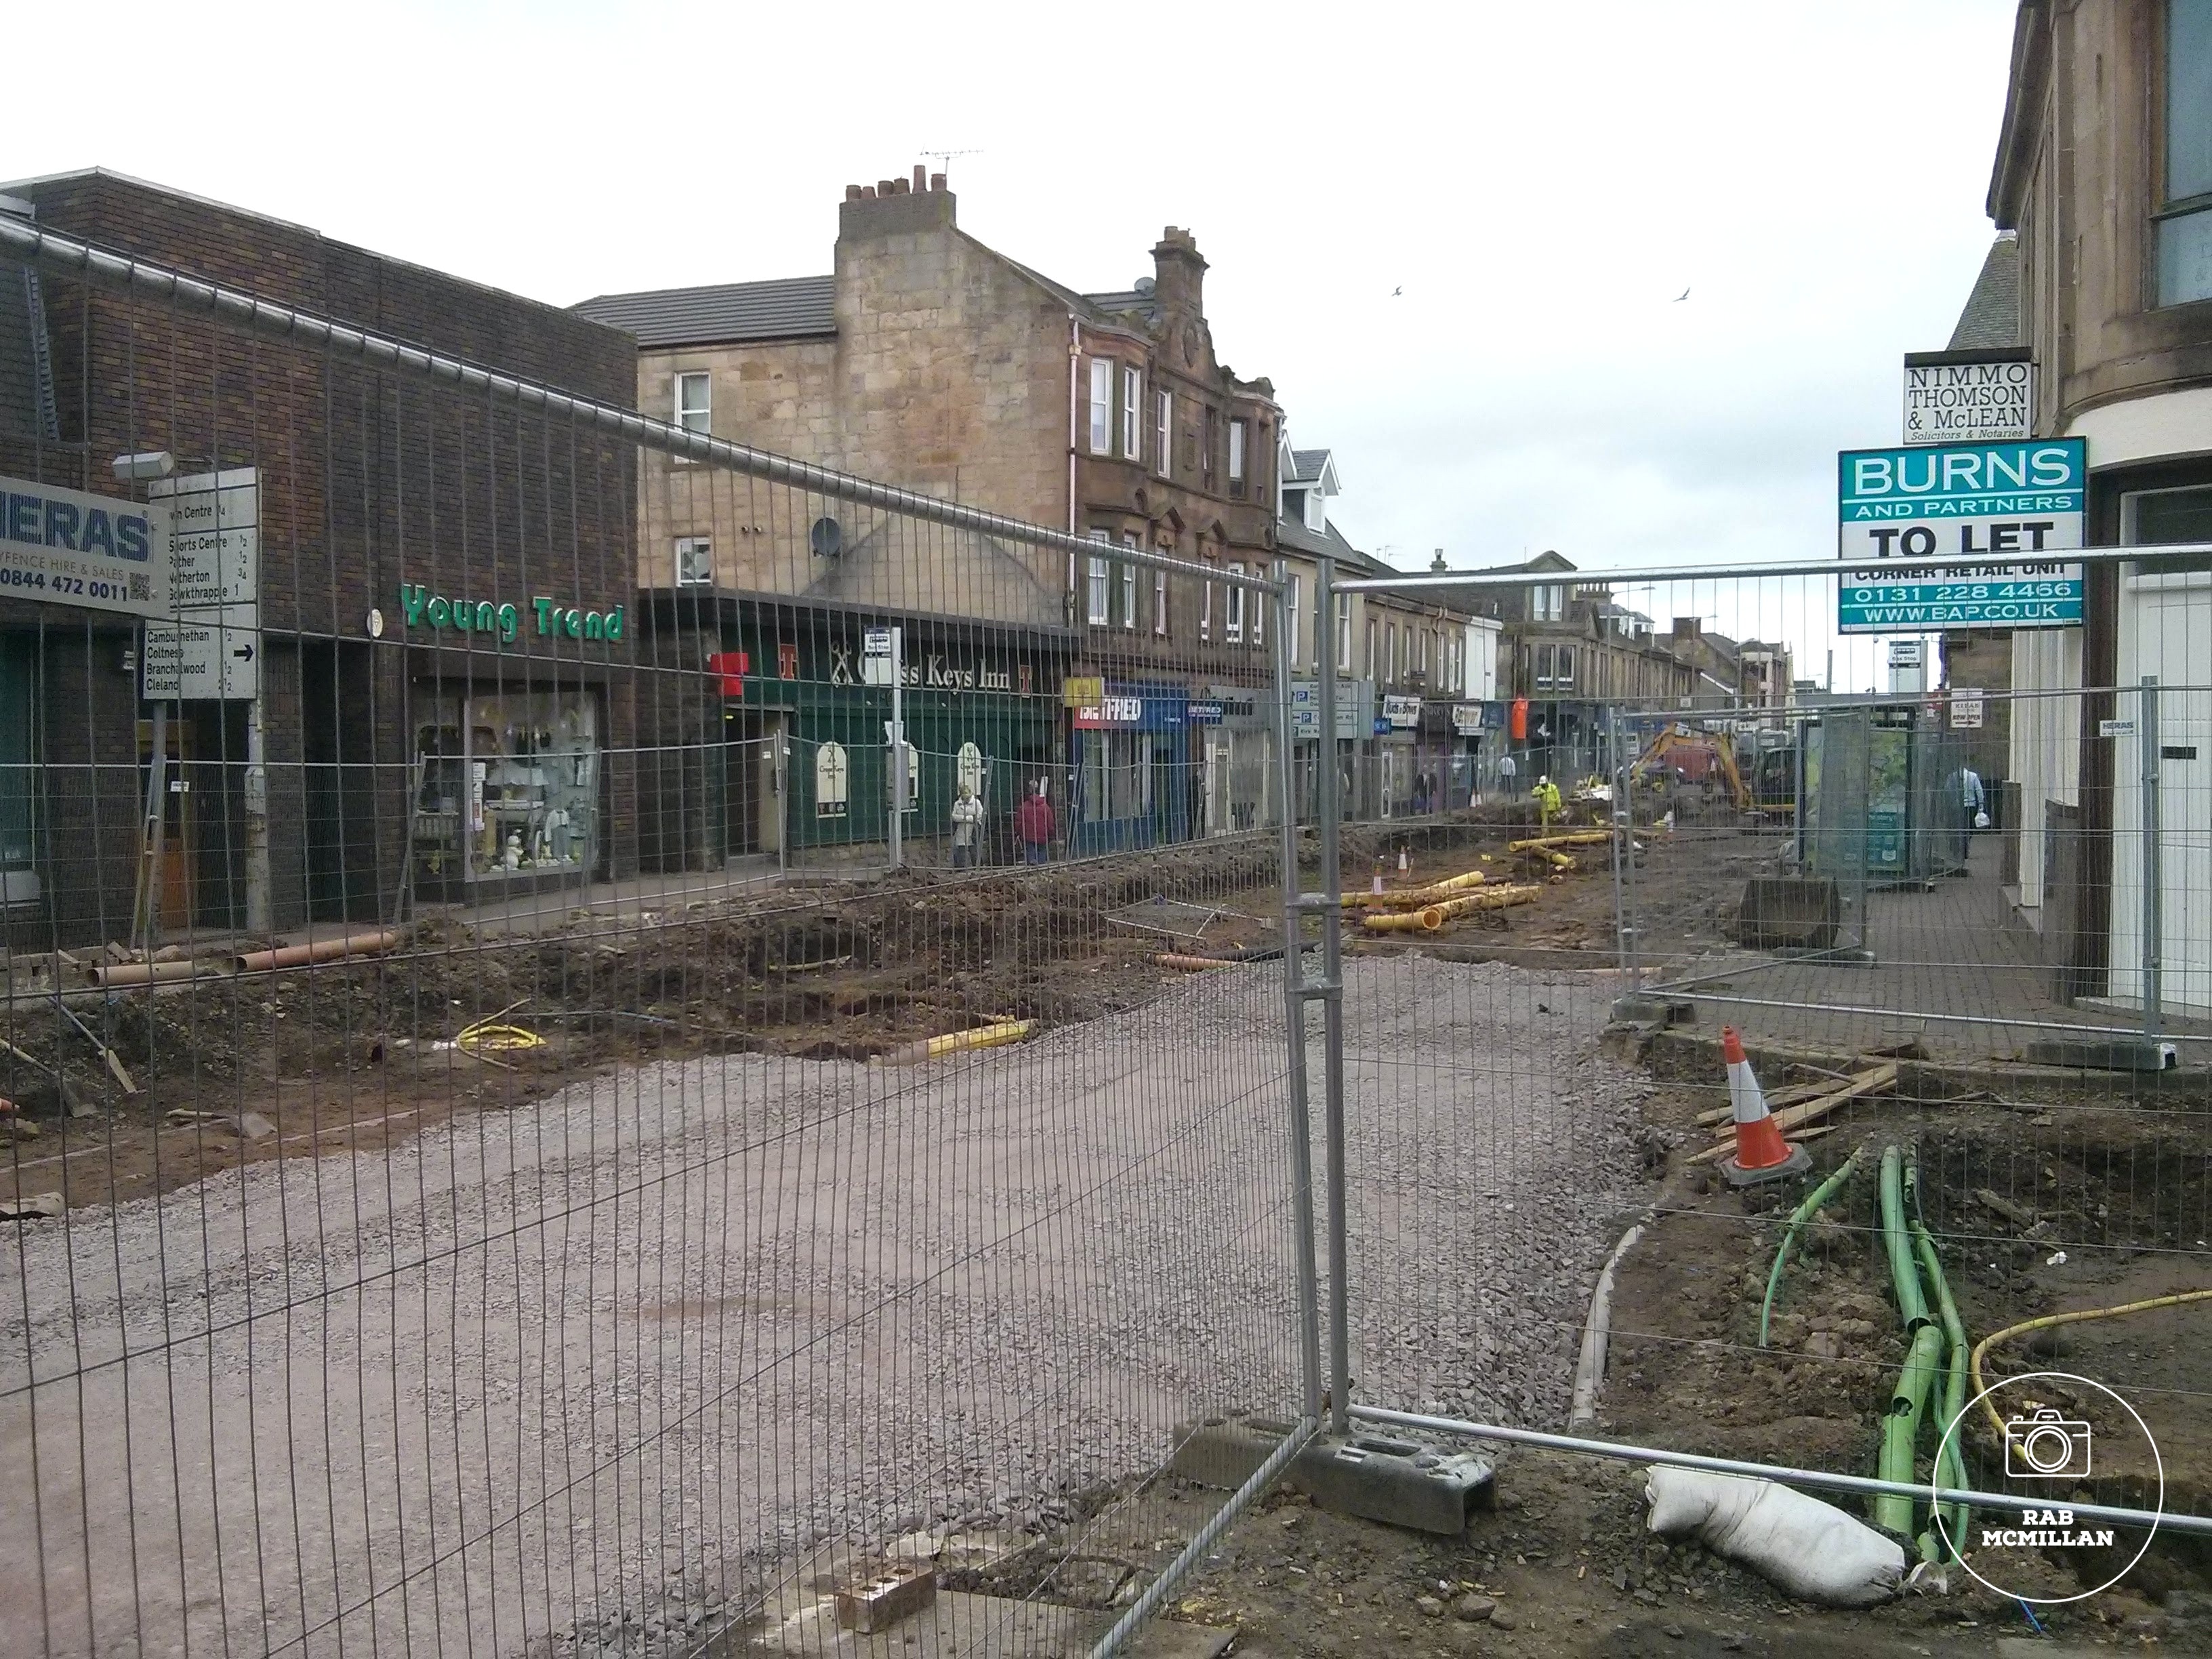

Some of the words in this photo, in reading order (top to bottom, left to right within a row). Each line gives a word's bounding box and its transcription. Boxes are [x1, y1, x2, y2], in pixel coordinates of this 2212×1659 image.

[1908, 364, 2027, 388] NIMMO
[1908, 386, 2026, 409] THOMSON
[1908, 411, 1922, 430] &
[1935, 407, 2026, 429] McLEAN
[1911, 430, 1961, 441] Solicitors
[1966, 430, 1973, 438] &
[1978, 428, 2024, 438] Notaries
[1854, 448, 2071, 495] BURNS
[184, 505, 212, 519] Centre
[1855, 504, 1912, 518] AND
[1924, 495, 2072, 515] PARTNERS
[0, 491, 148, 562] ERAS
[169, 539, 197, 552] Sorts
[1869, 527, 1936, 556] TO
[1961, 521, 2054, 553] LET
[51, 558, 76, 574] HIRE
[81, 564, 87, 575] &
[92, 565, 124, 581] SALES
[0, 568, 45, 589] 0844
[52, 576, 83, 595] 472
[89, 581, 127, 602] 0011
[1855, 587, 1921, 602] 0131
[1936, 585, 1989, 601] 228
[1998, 582, 2072, 598] 4466
[401, 583, 517, 643] Young
[533, 596, 623, 640] Trend
[1864, 603, 2059, 622] WWW.BAP.CO.UK
[926, 654, 973, 695] Keys
[979, 659, 1011, 689] Inn
